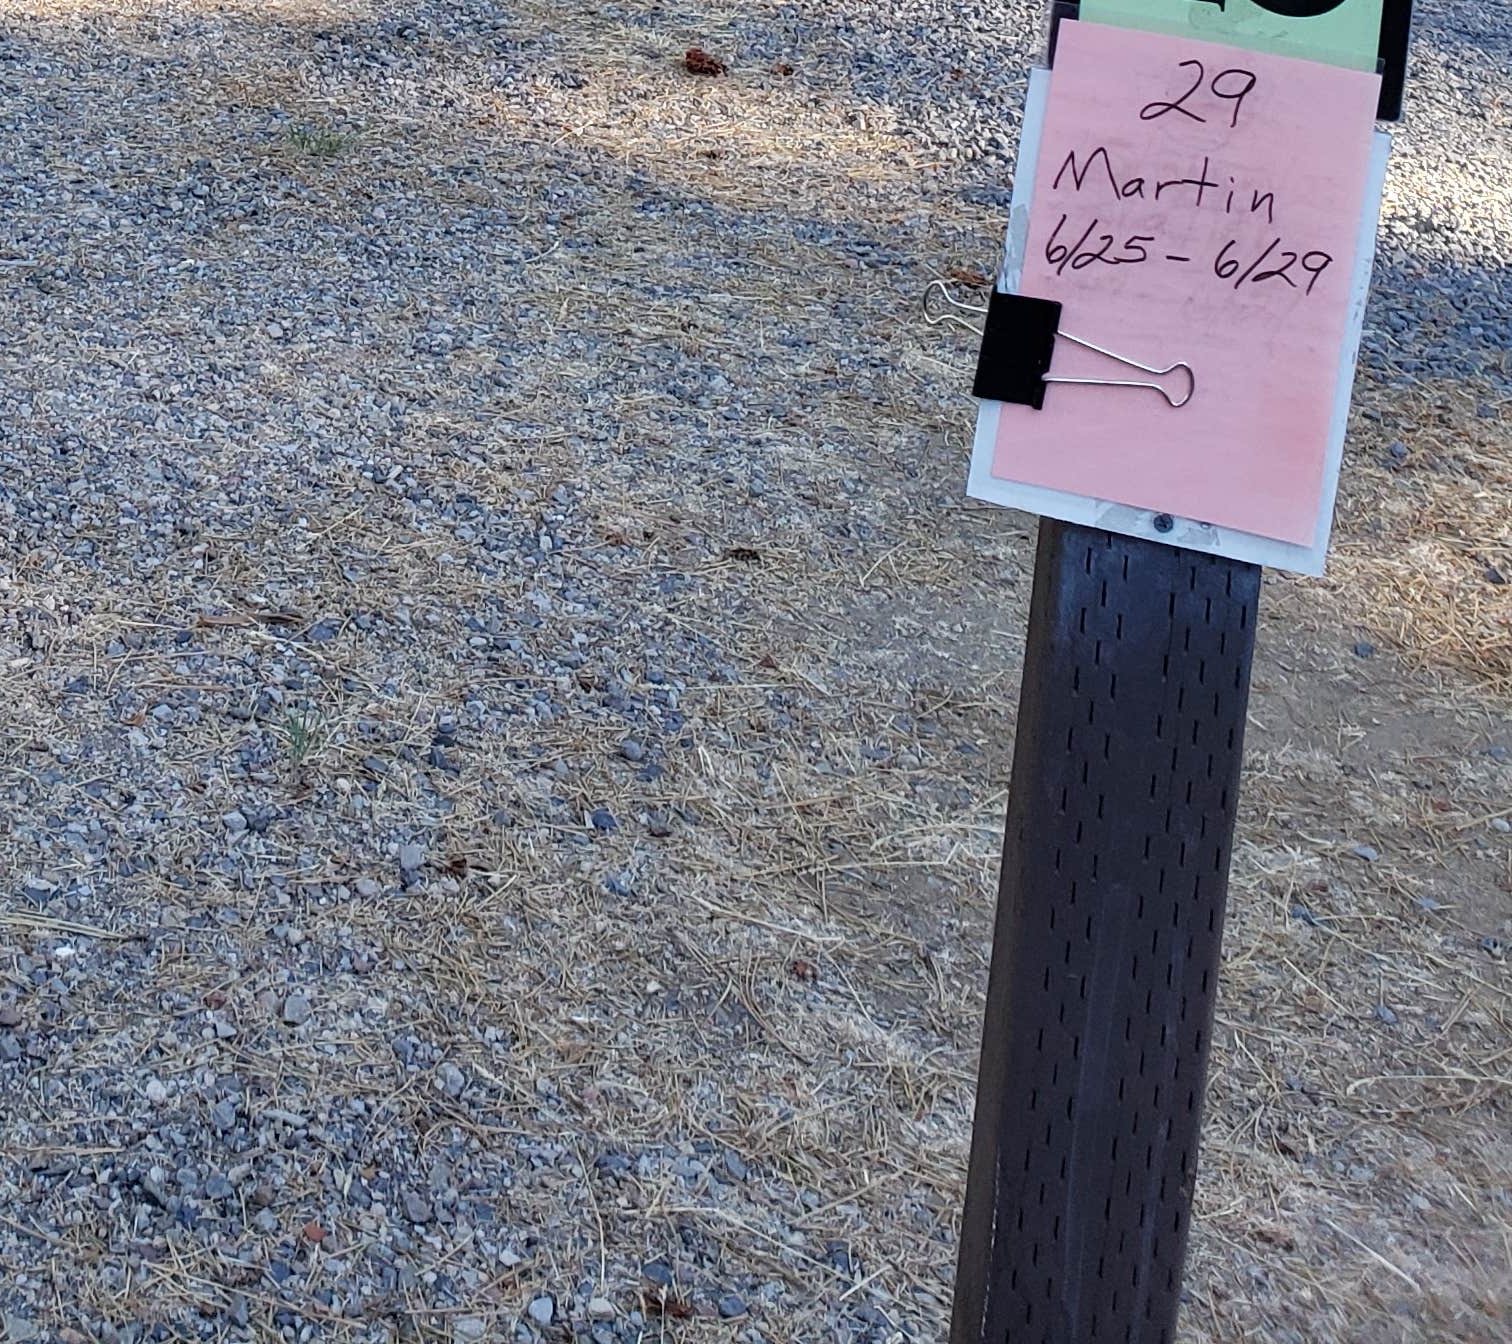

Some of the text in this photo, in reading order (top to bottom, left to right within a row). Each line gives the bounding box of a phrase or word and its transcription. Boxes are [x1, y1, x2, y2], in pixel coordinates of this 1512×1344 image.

[1140, 59, 1256, 128] 29
[1053, 147, 1274, 224] Martin
[1045, 214, 1155, 276] 6/25
[1214, 237, 1333, 296] 6/29
